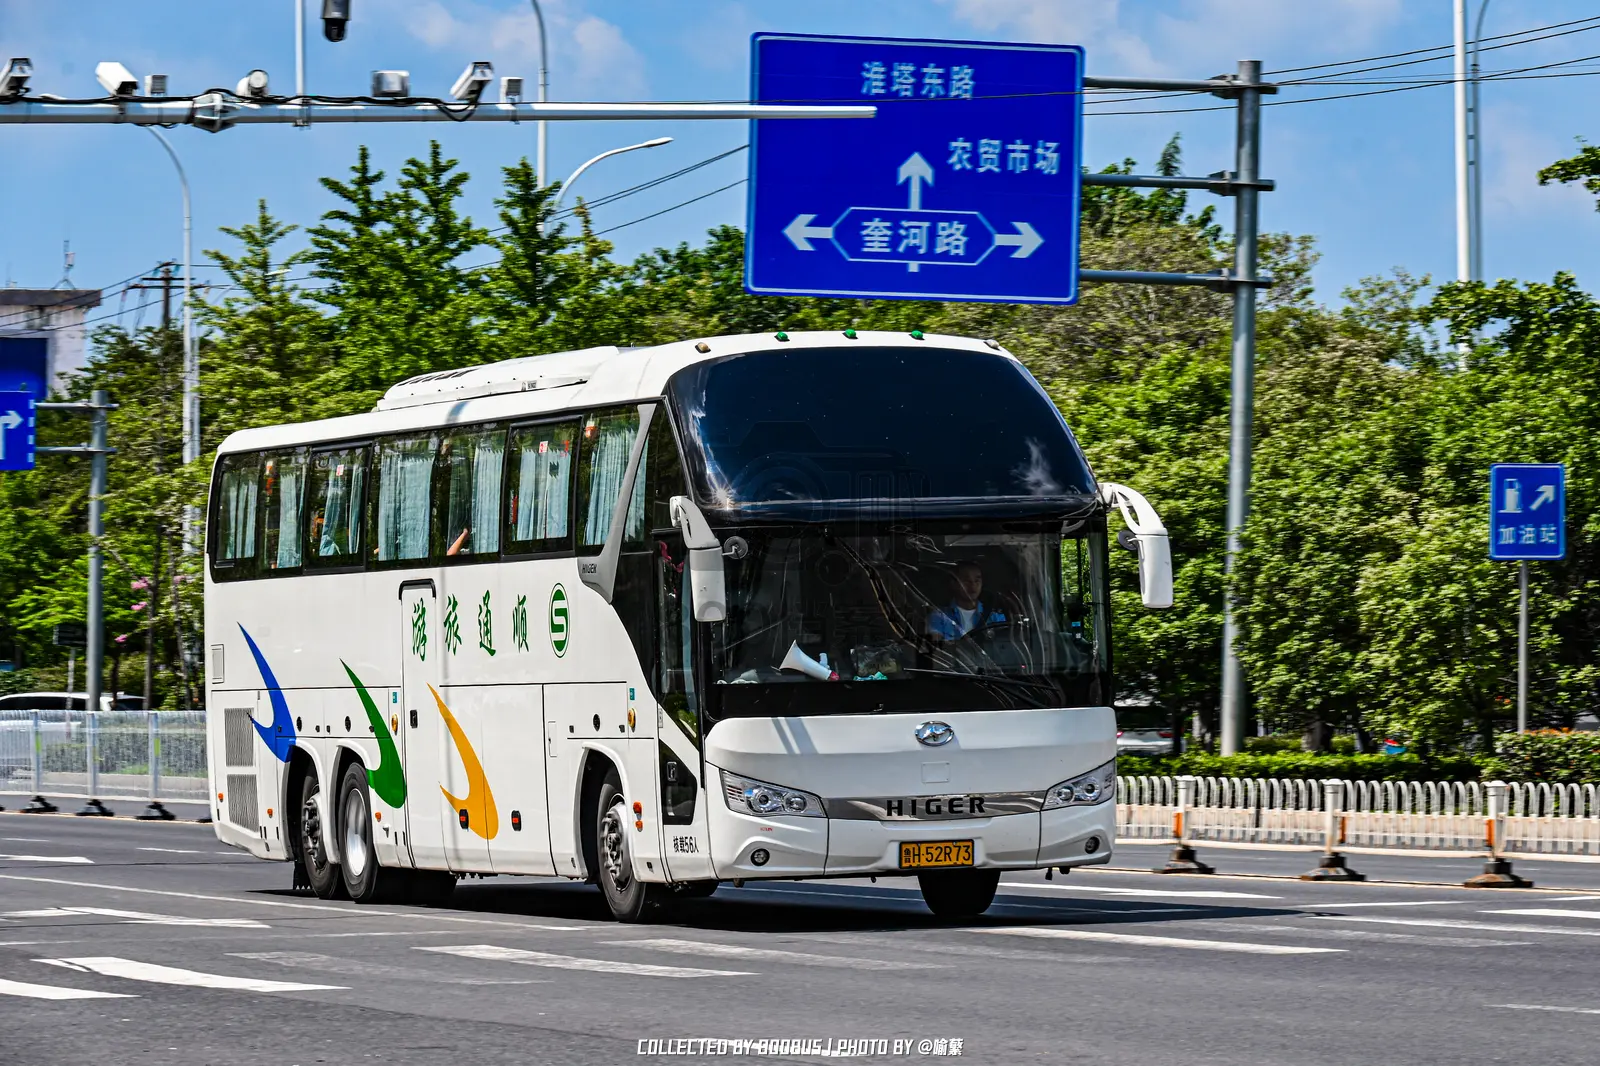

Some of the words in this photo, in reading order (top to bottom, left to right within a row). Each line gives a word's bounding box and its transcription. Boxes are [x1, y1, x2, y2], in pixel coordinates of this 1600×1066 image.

[861, 61, 976, 99] 淮塔东路
[947, 137, 1060, 175] 农贸市场
[860, 217, 969, 257] 奎河路
[1498, 524, 1557, 545] 加油站
[886, 797, 987, 817] HIGER
